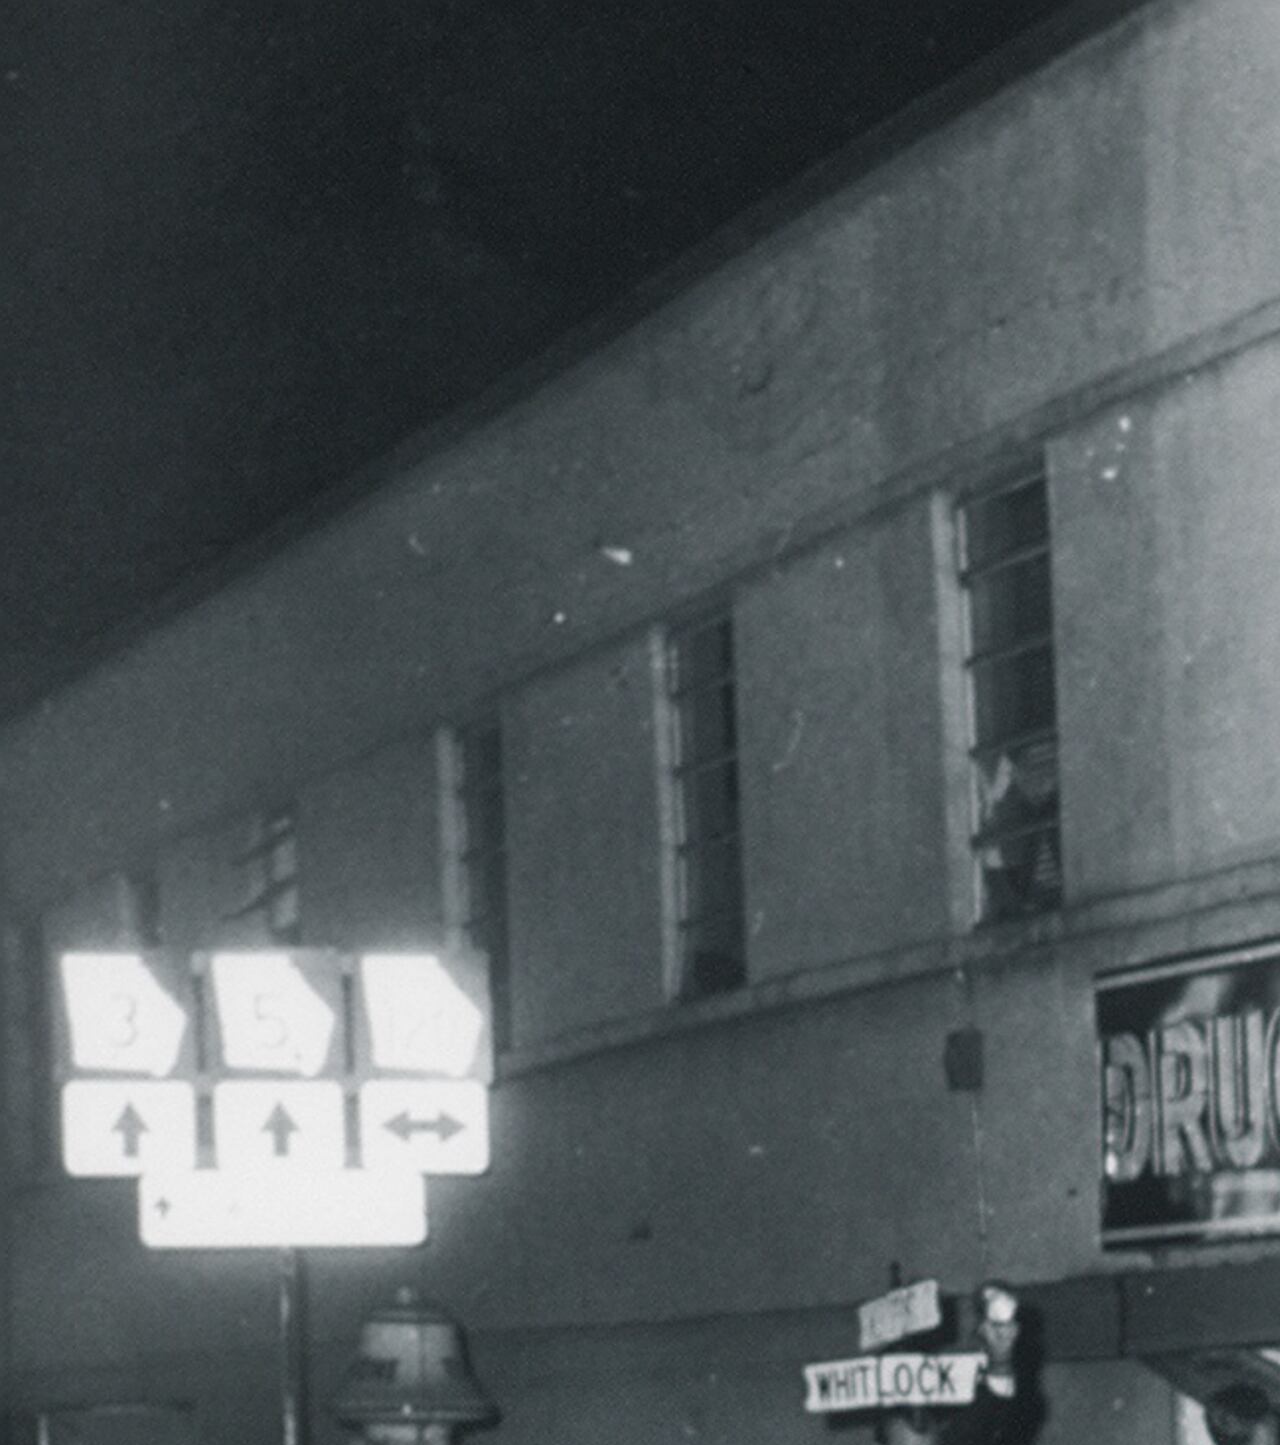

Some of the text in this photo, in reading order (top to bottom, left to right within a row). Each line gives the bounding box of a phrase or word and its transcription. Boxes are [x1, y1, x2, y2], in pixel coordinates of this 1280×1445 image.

[108, 992, 139, 1050] 3
[251, 990, 290, 1050] 5
[815, 1360, 958, 1402] WHITLOCK
